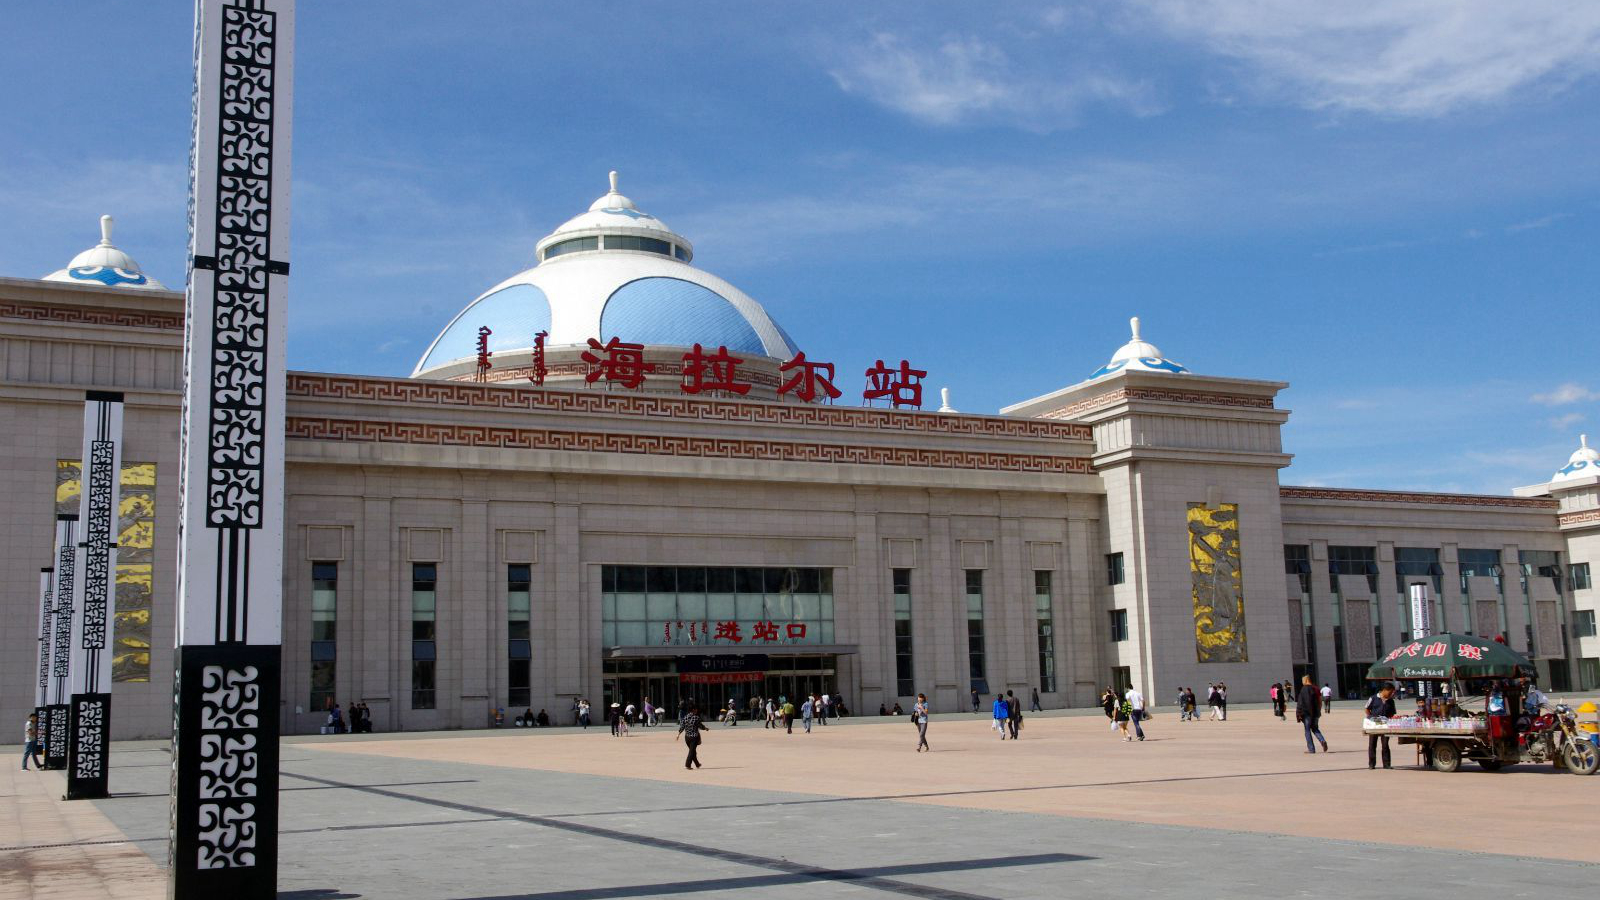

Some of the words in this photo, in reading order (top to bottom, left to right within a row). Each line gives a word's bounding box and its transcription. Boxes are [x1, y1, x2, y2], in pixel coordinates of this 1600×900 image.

[581, 336, 928, 406] 海拉尔站
[714, 620, 807, 642] 进站口
